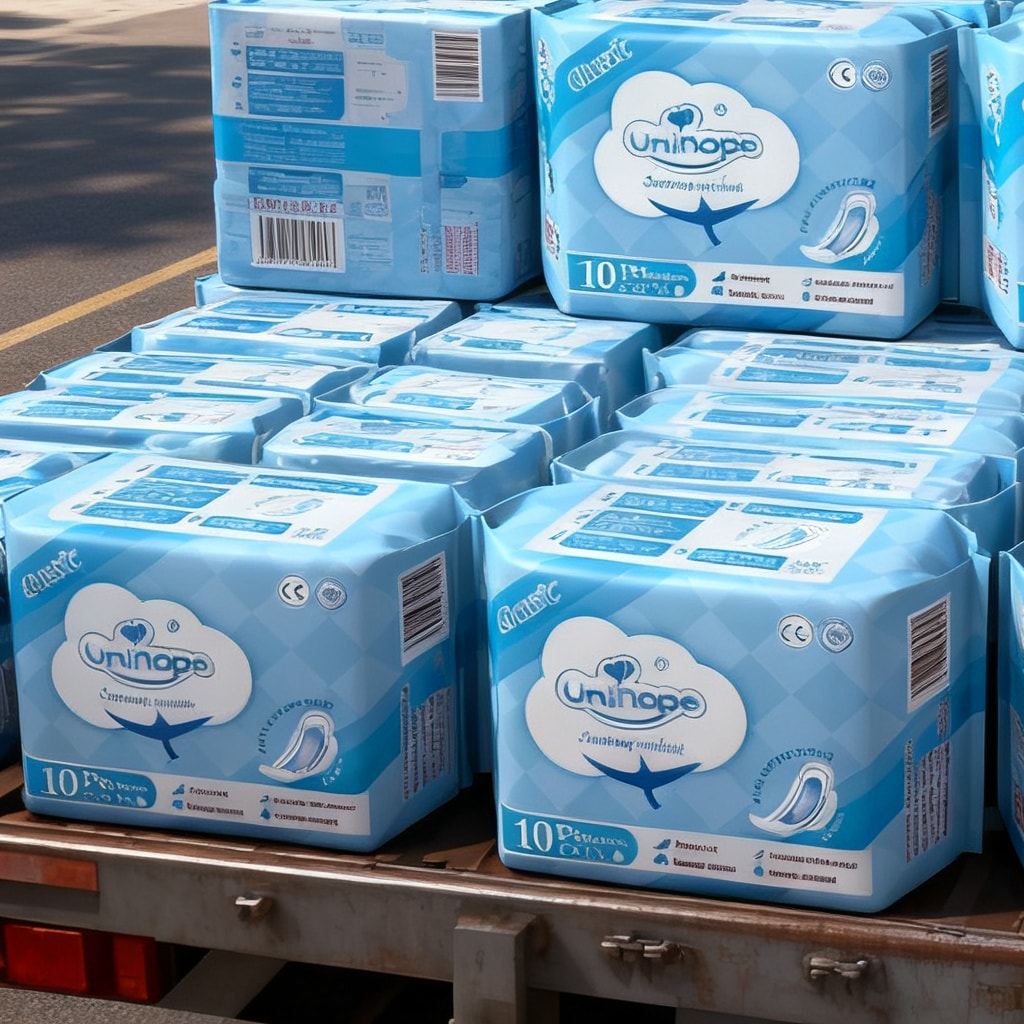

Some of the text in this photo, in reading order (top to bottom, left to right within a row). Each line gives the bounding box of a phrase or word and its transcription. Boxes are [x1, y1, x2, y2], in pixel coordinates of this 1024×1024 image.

[577, 260, 615, 289] 10
[41, 767, 79, 797] 10
[514, 818, 553, 853] 10
